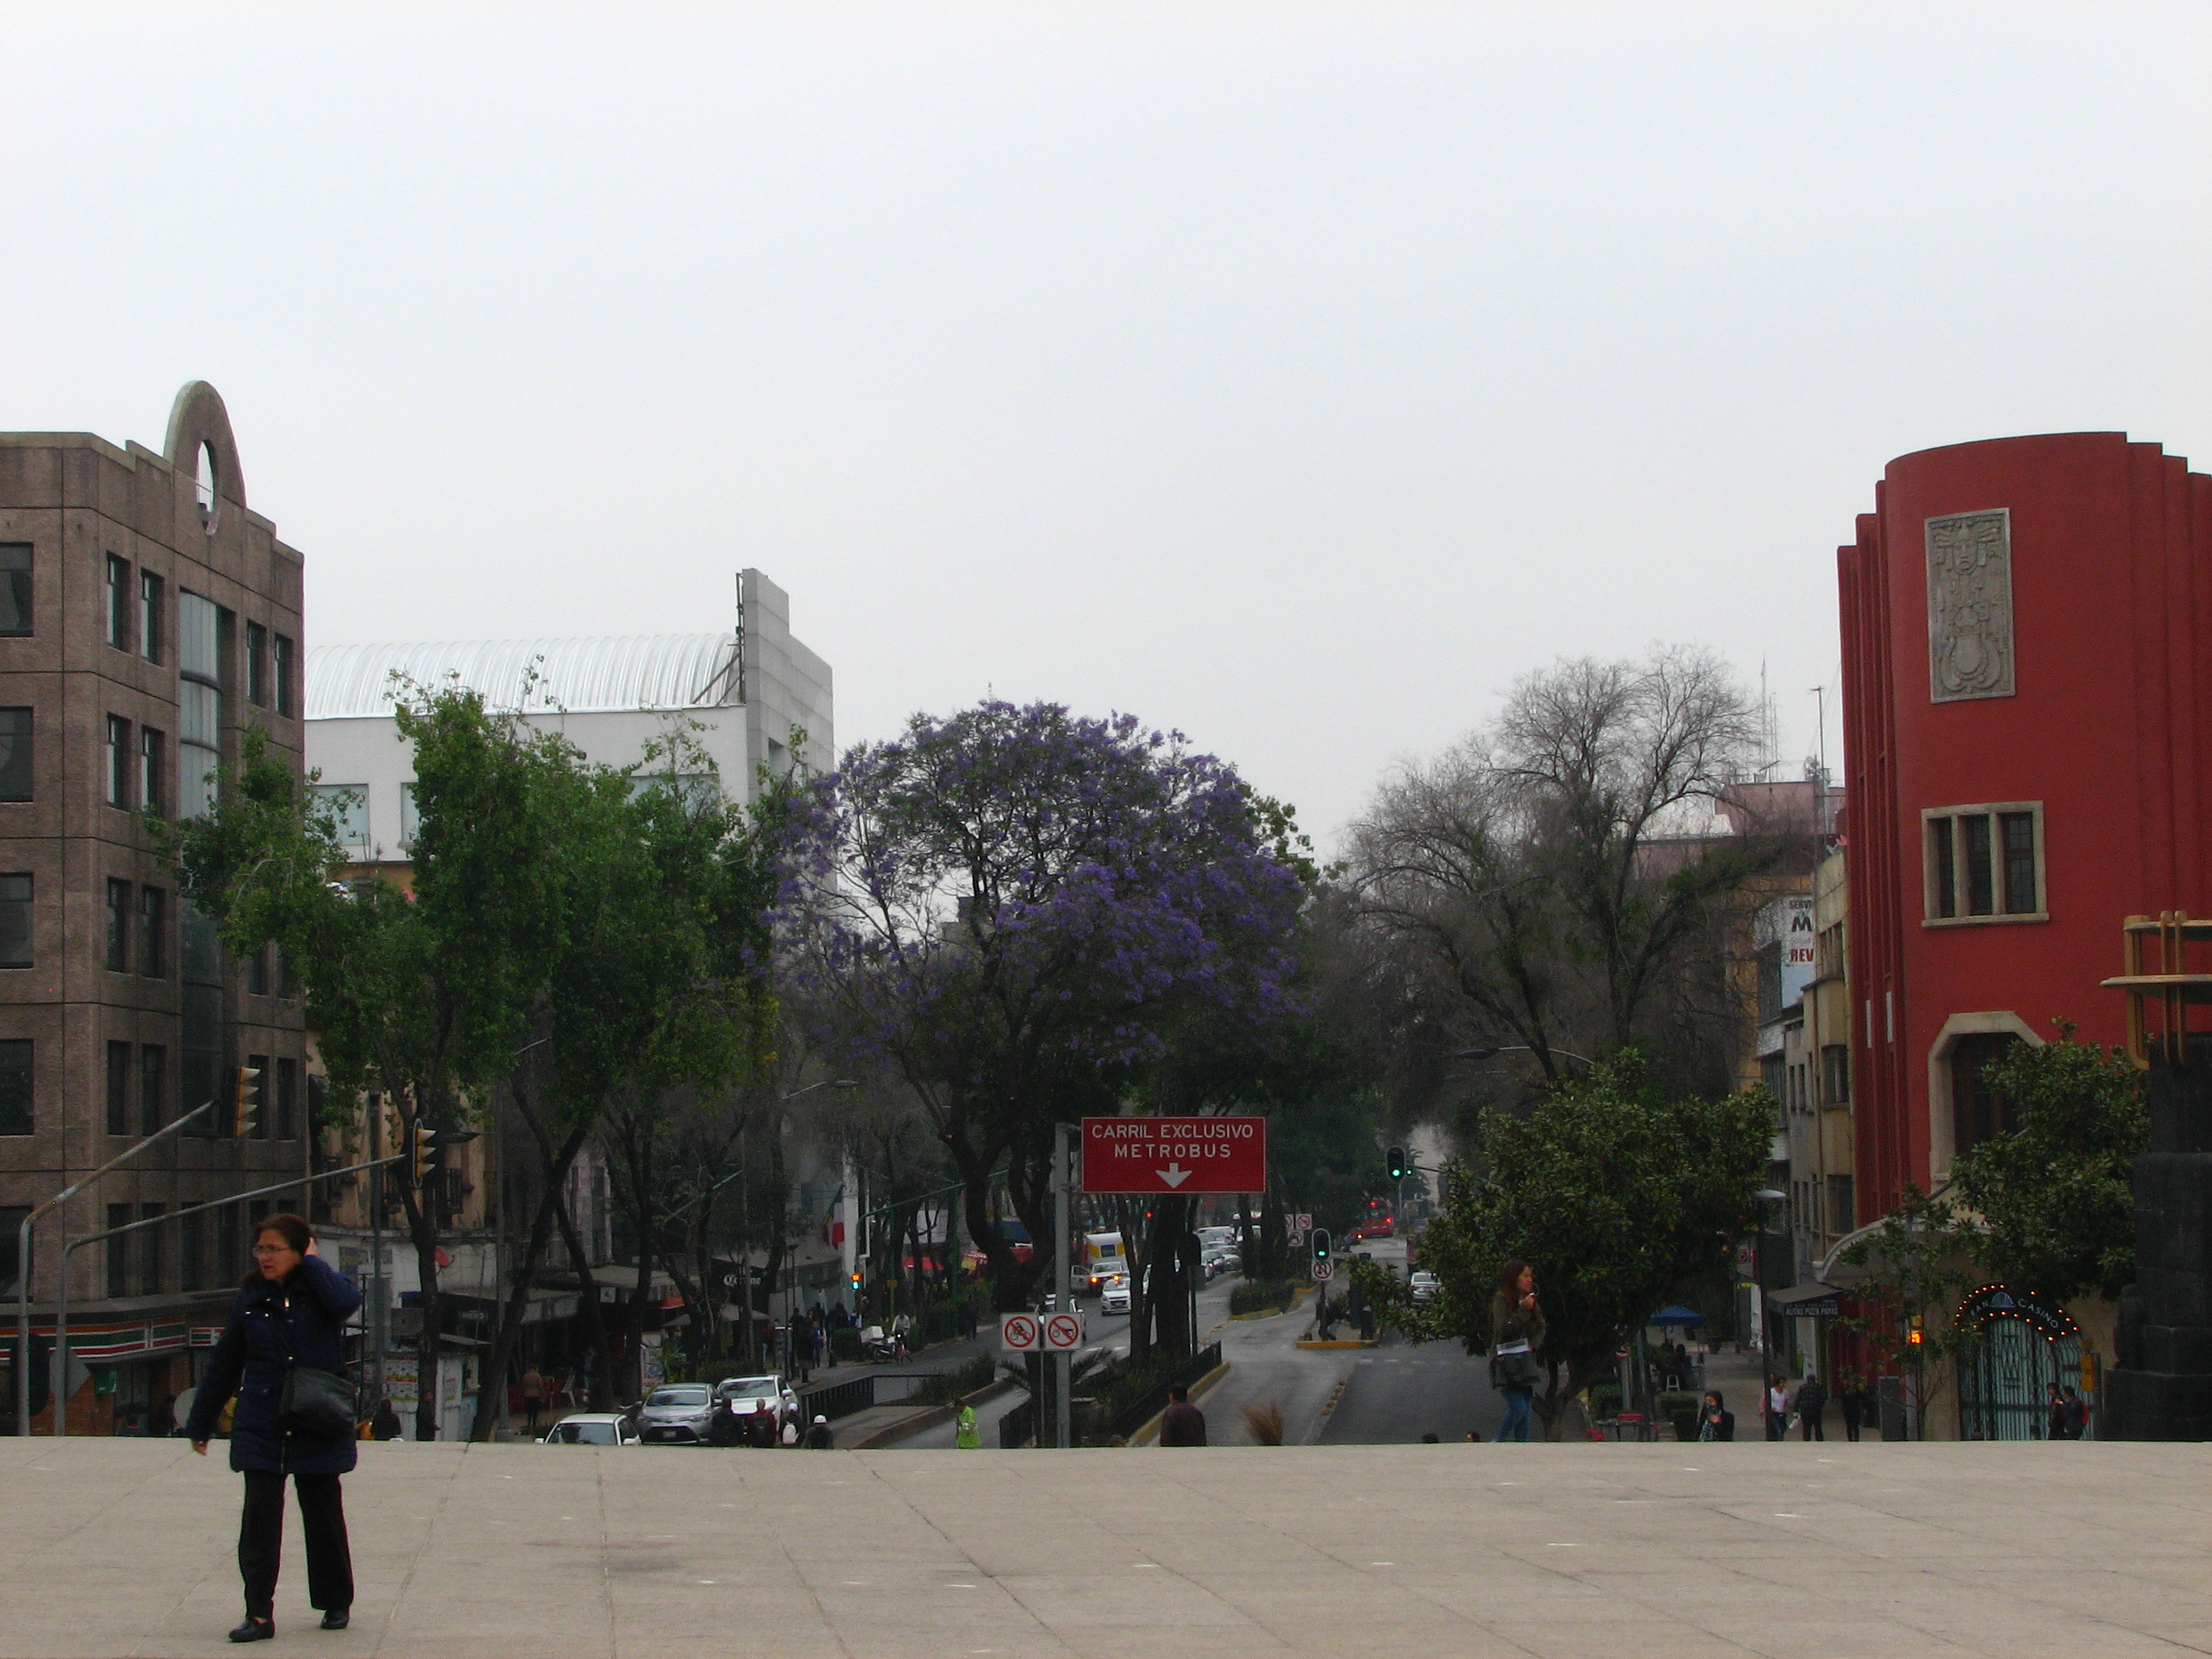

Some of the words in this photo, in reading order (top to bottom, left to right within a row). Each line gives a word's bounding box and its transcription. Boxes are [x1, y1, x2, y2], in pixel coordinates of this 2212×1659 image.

[1092, 1124, 1154, 1139] CARRIL
[1160, 1123, 1254, 1139] EXCLUSIVO
[1114, 1144, 1232, 1159] METROBUS
[2016, 1298, 2060, 1328] CASINO
